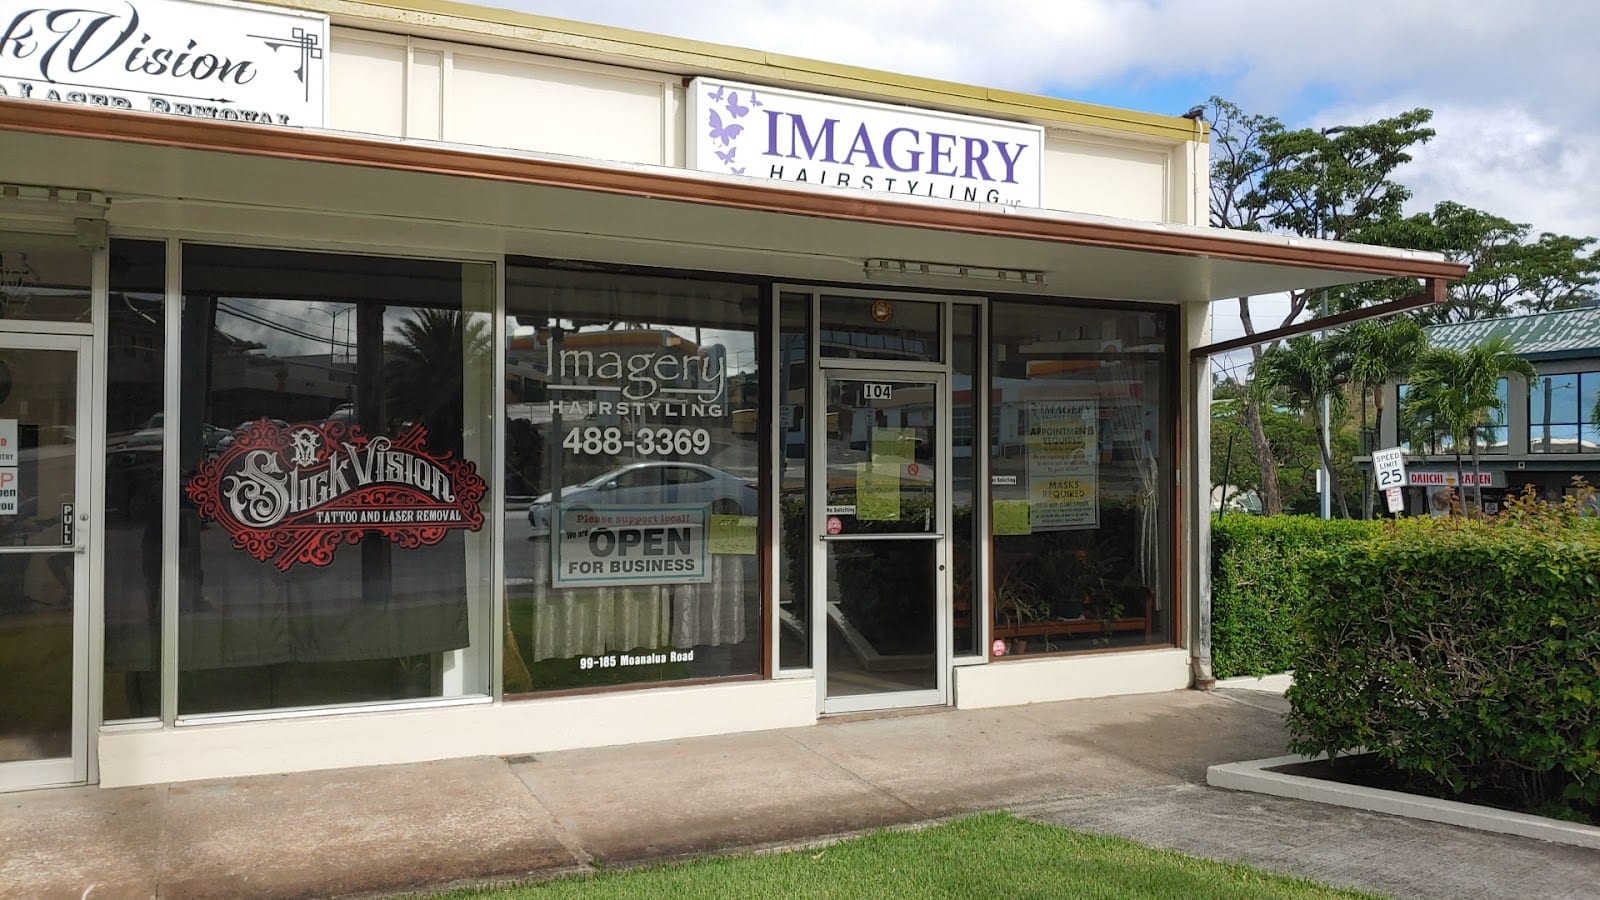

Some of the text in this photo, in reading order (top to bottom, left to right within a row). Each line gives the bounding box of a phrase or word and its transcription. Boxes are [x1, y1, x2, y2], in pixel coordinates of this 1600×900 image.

[40, 1, 256, 84] Vision
[761, 109, 1029, 185] IMAGERY
[769, 164, 1000, 204] HAIRSTYLING
[546, 336, 725, 404] Imagery
[866, 385, 891, 399] 104
[549, 400, 724, 418] HAIRSTYLING
[562, 427, 711, 456] 488-3369
[1376, 452, 1399, 463] SPEED
[1379, 461, 1397, 469] LIMIT
[1048, 480, 1080, 489] MASKS
[1380, 468, 1402, 485] 25
[1411, 473, 1443, 484] DAIICHI
[63, 505, 72, 544] PULL
[316, 510, 462, 523] TATTOO AND LASER REMOVAL
[576, 513, 690, 525] Please support local!
[588, 526, 691, 557] OPEN
[568, 558, 695, 574] FOR BUSINESS
[580, 650, 694, 669] 99-185 Moanalua Road
